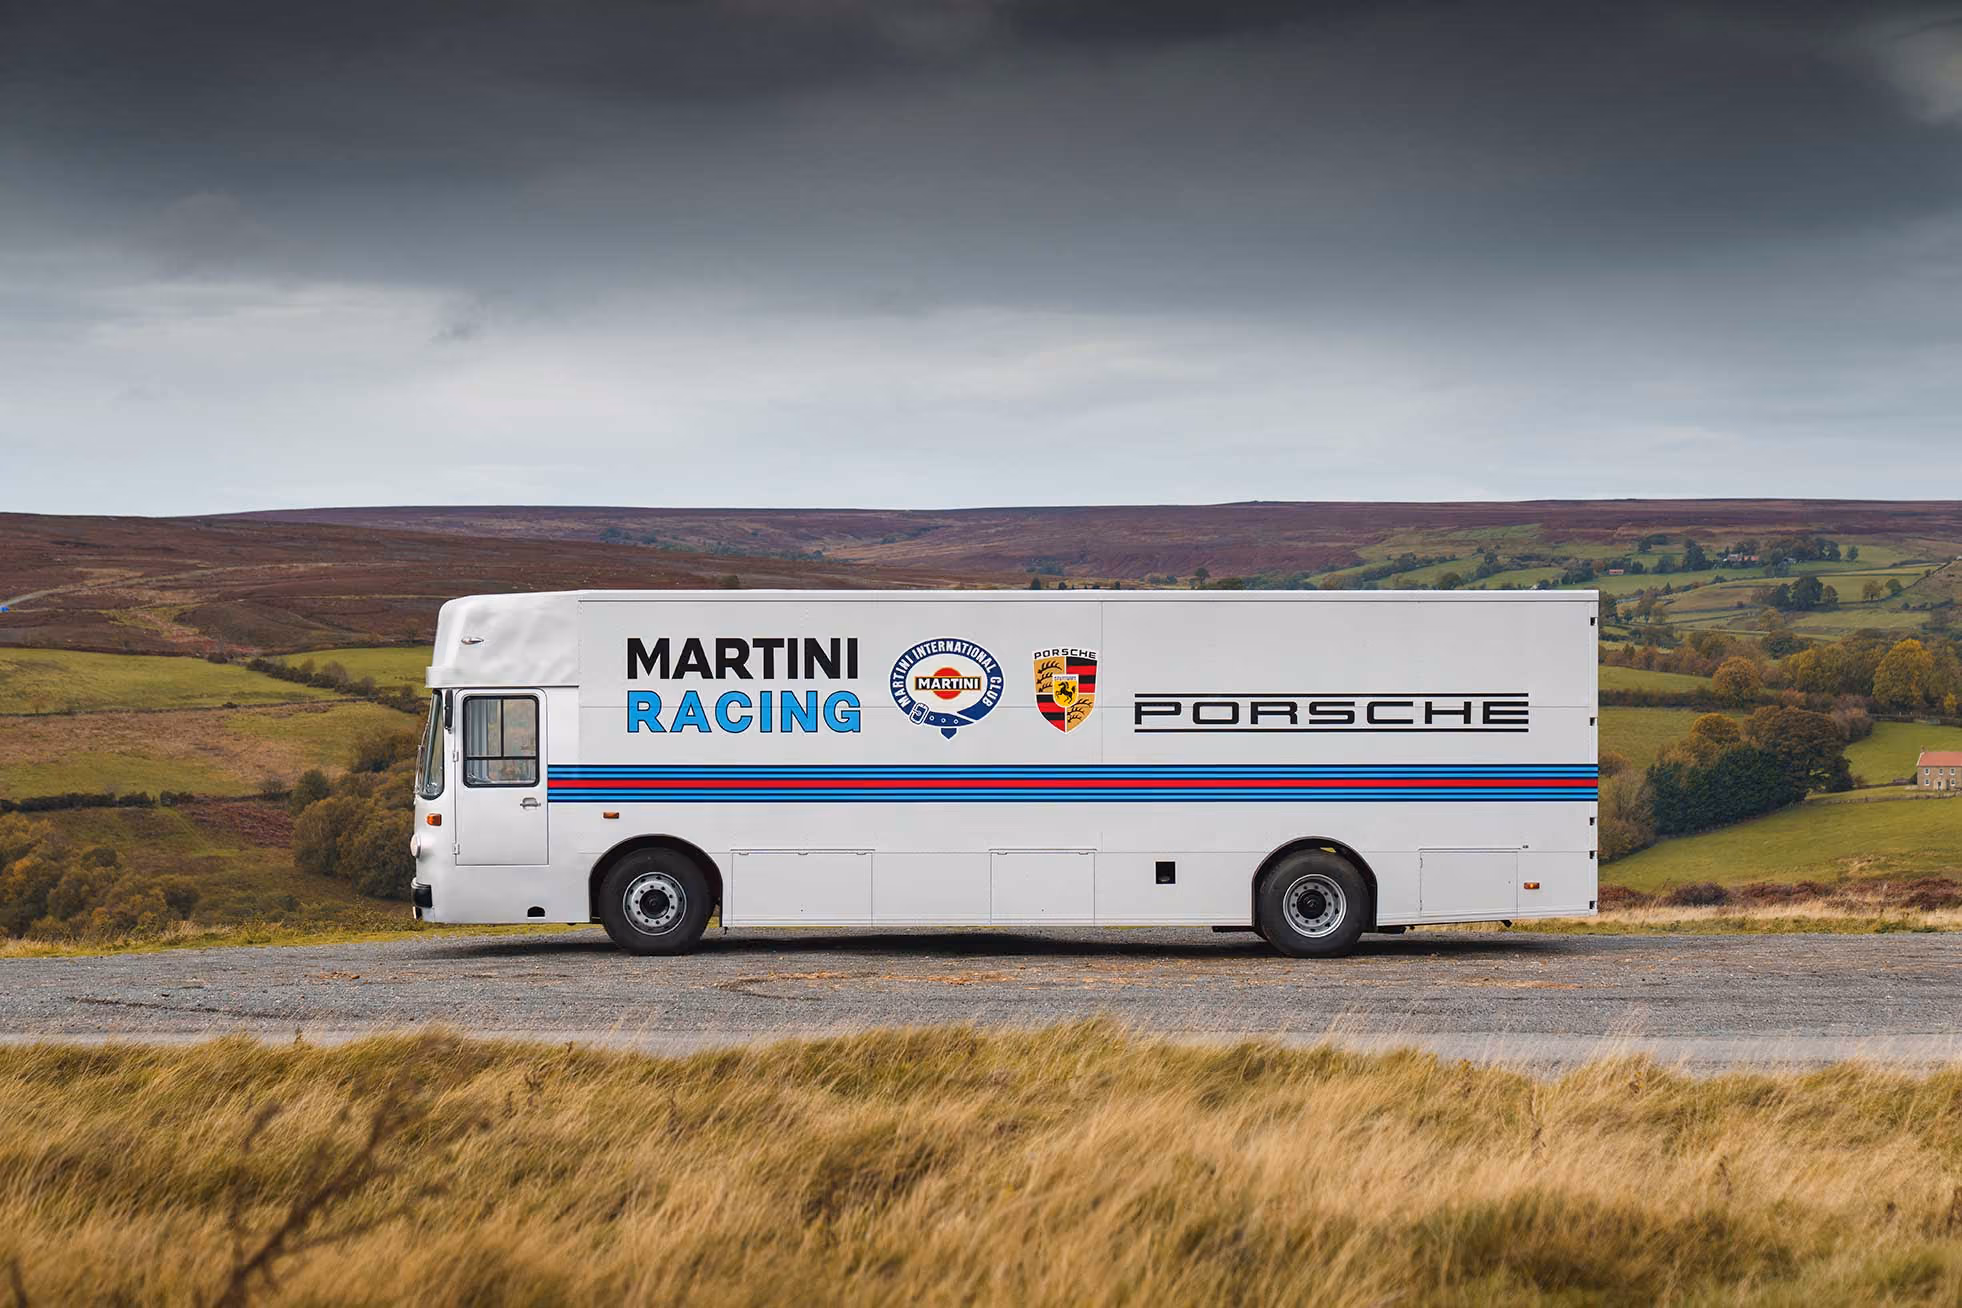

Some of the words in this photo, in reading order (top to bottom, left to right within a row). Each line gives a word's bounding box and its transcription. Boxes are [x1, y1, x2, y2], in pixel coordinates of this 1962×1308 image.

[627, 638, 858, 679] MARTINI
[1034, 648, 1096, 659] PORSCHE
[892, 655, 914, 708] MARTINI
[912, 641, 996, 673] INTERNATIONAL
[982, 676, 1002, 707] CLUB
[918, 678, 979, 689] MARTINI
[627, 690, 861, 733] RACING
[1134, 701, 1529, 725] PORSCHE
